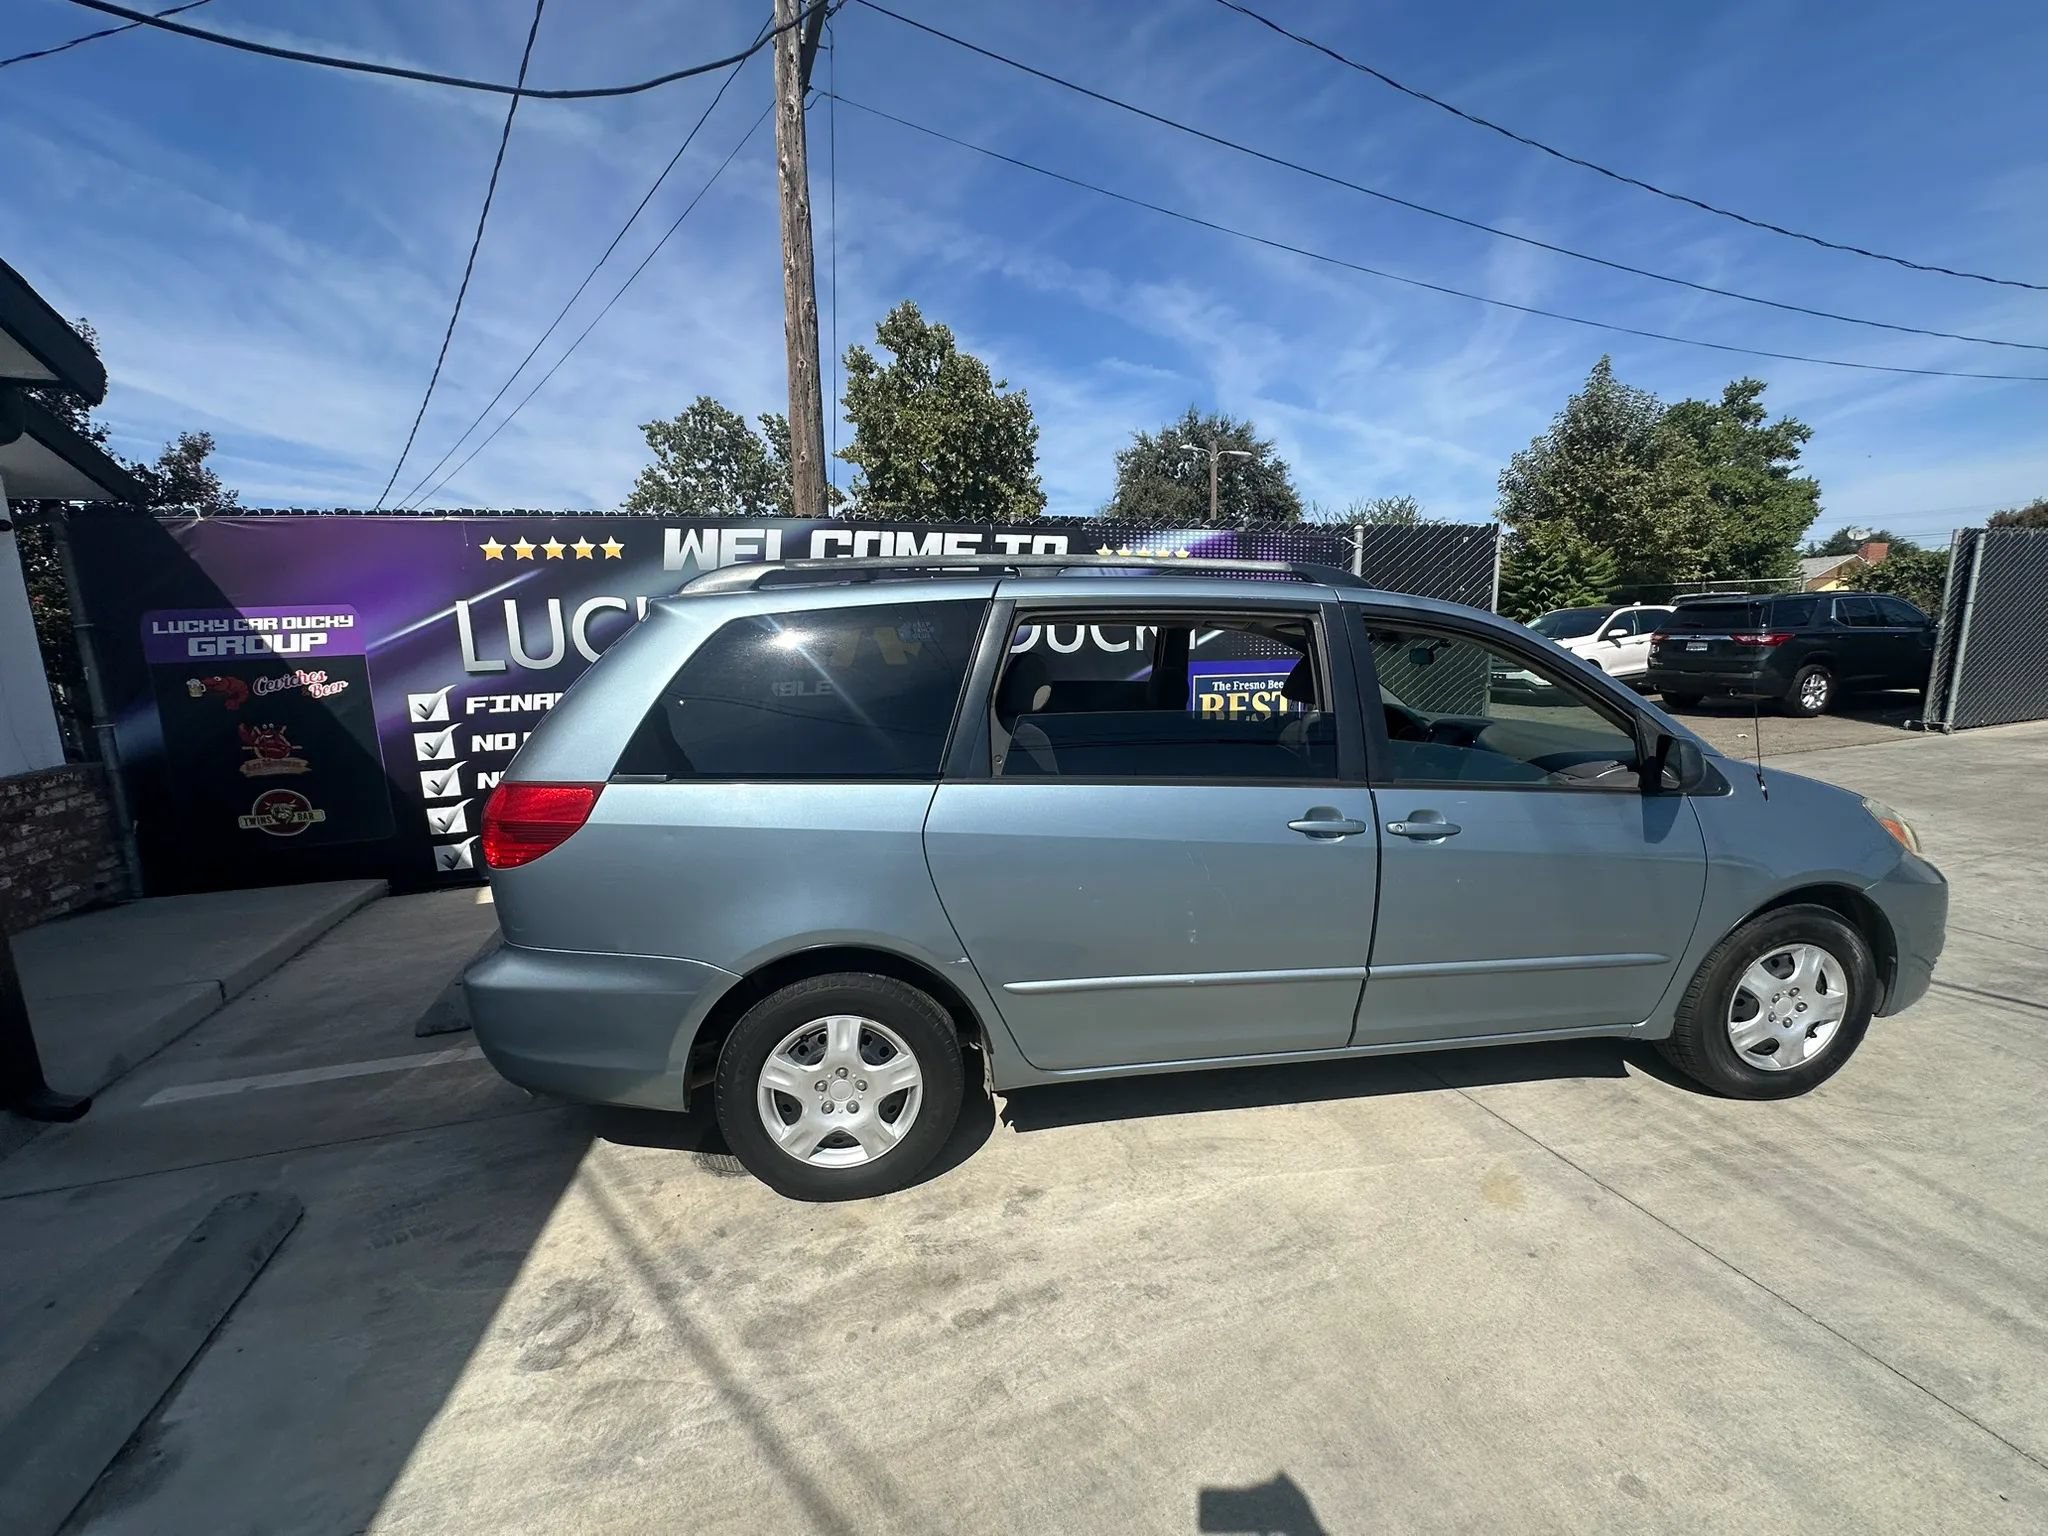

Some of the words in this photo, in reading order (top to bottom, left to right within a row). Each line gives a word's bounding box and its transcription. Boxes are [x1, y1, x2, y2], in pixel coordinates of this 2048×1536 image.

[152, 618, 230, 635] LUCKY
[233, 617, 279, 633] CAR
[281, 615, 354, 630] DUCKY
[456, 596, 648, 672] LUC
[188, 633, 328, 657] GROUP
[253, 669, 328, 696] Ceviches
[308, 680, 349, 699] Beer
[1212, 681, 1231, 692] The
[1233, 680, 1266, 691] Fresno
[1268, 679, 1285, 690] Bee
[1199, 690, 1288, 722] BEST
[471, 732, 517, 753] NO
[477, 770, 506, 790] N
[243, 815, 273, 826] TWINS
[297, 810, 315, 821] BAR
